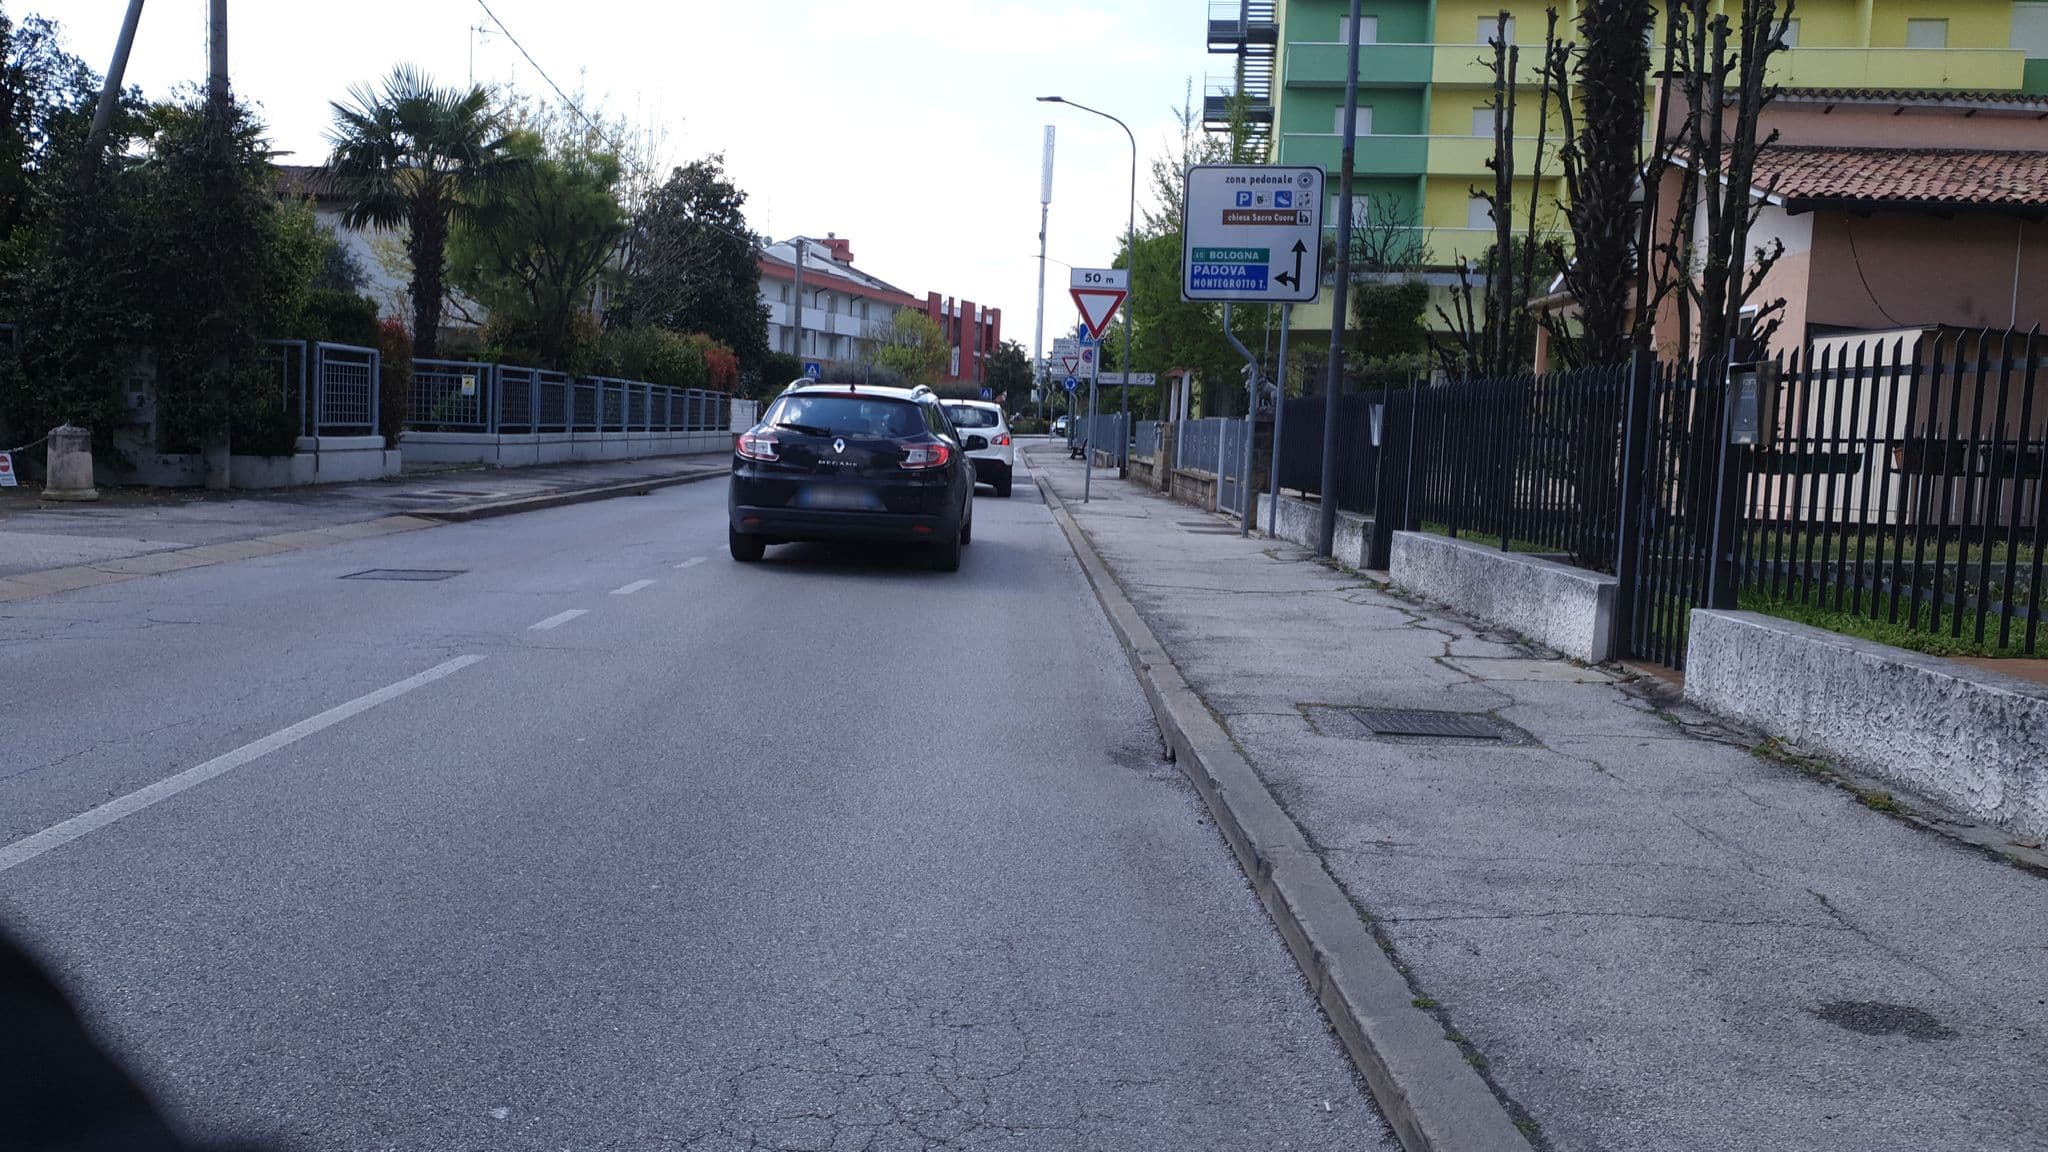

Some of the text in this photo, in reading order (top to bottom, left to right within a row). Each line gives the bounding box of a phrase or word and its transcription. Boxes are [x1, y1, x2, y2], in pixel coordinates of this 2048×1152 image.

[1225, 174, 1293, 186] zona pedonale
[1239, 193, 1250, 204] P
[1228, 212, 1295, 222] chiesa Sacro Cuore
[1209, 250, 1259, 260] BOLOGNA
[1193, 265, 1246, 276] PADOVA
[1084, 273, 1114, 284] 50 m
[1193, 278, 1266, 289] MONTEGROTTO T.
